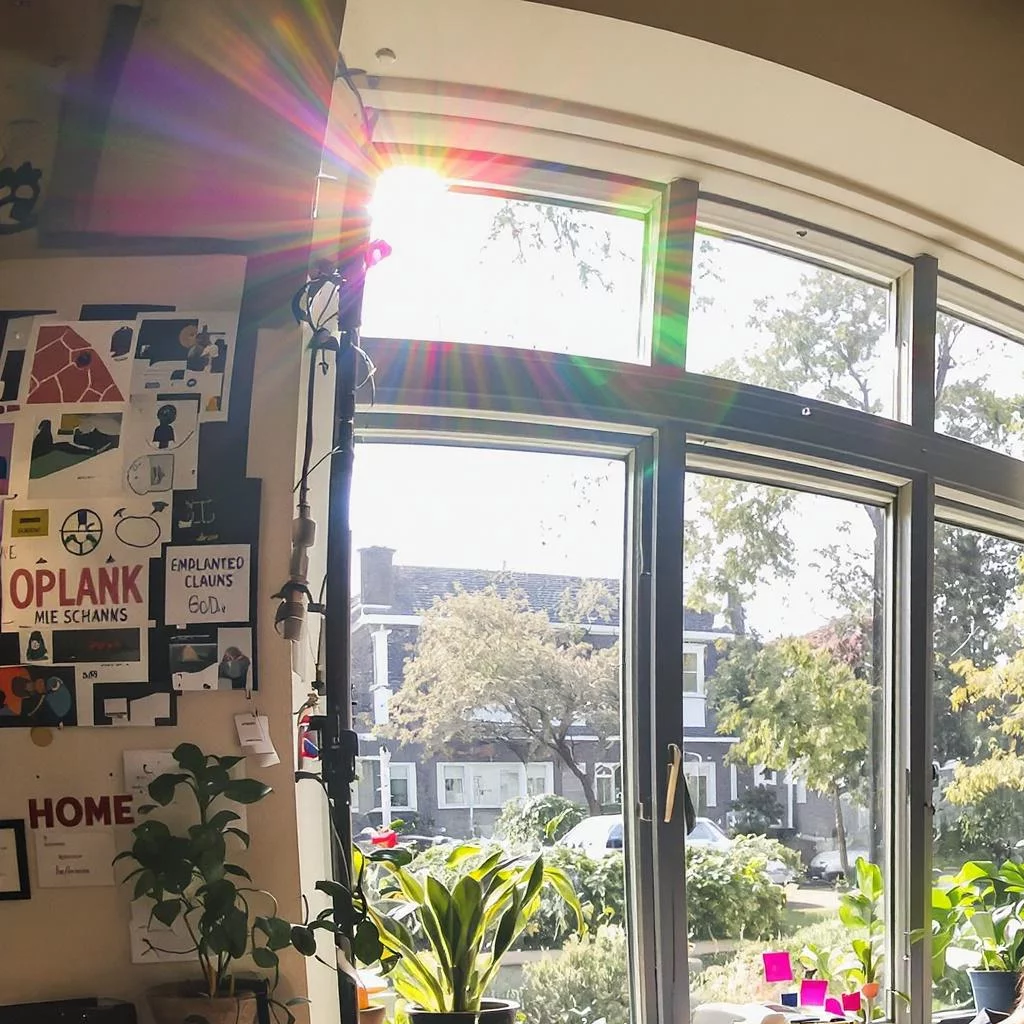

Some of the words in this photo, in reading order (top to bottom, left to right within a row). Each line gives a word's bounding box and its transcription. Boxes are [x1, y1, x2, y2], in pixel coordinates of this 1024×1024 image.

[9, 564, 143, 609] OPLANK
[184, 574, 233, 588] CLAUNS
[28, 795, 135, 829] HOME
